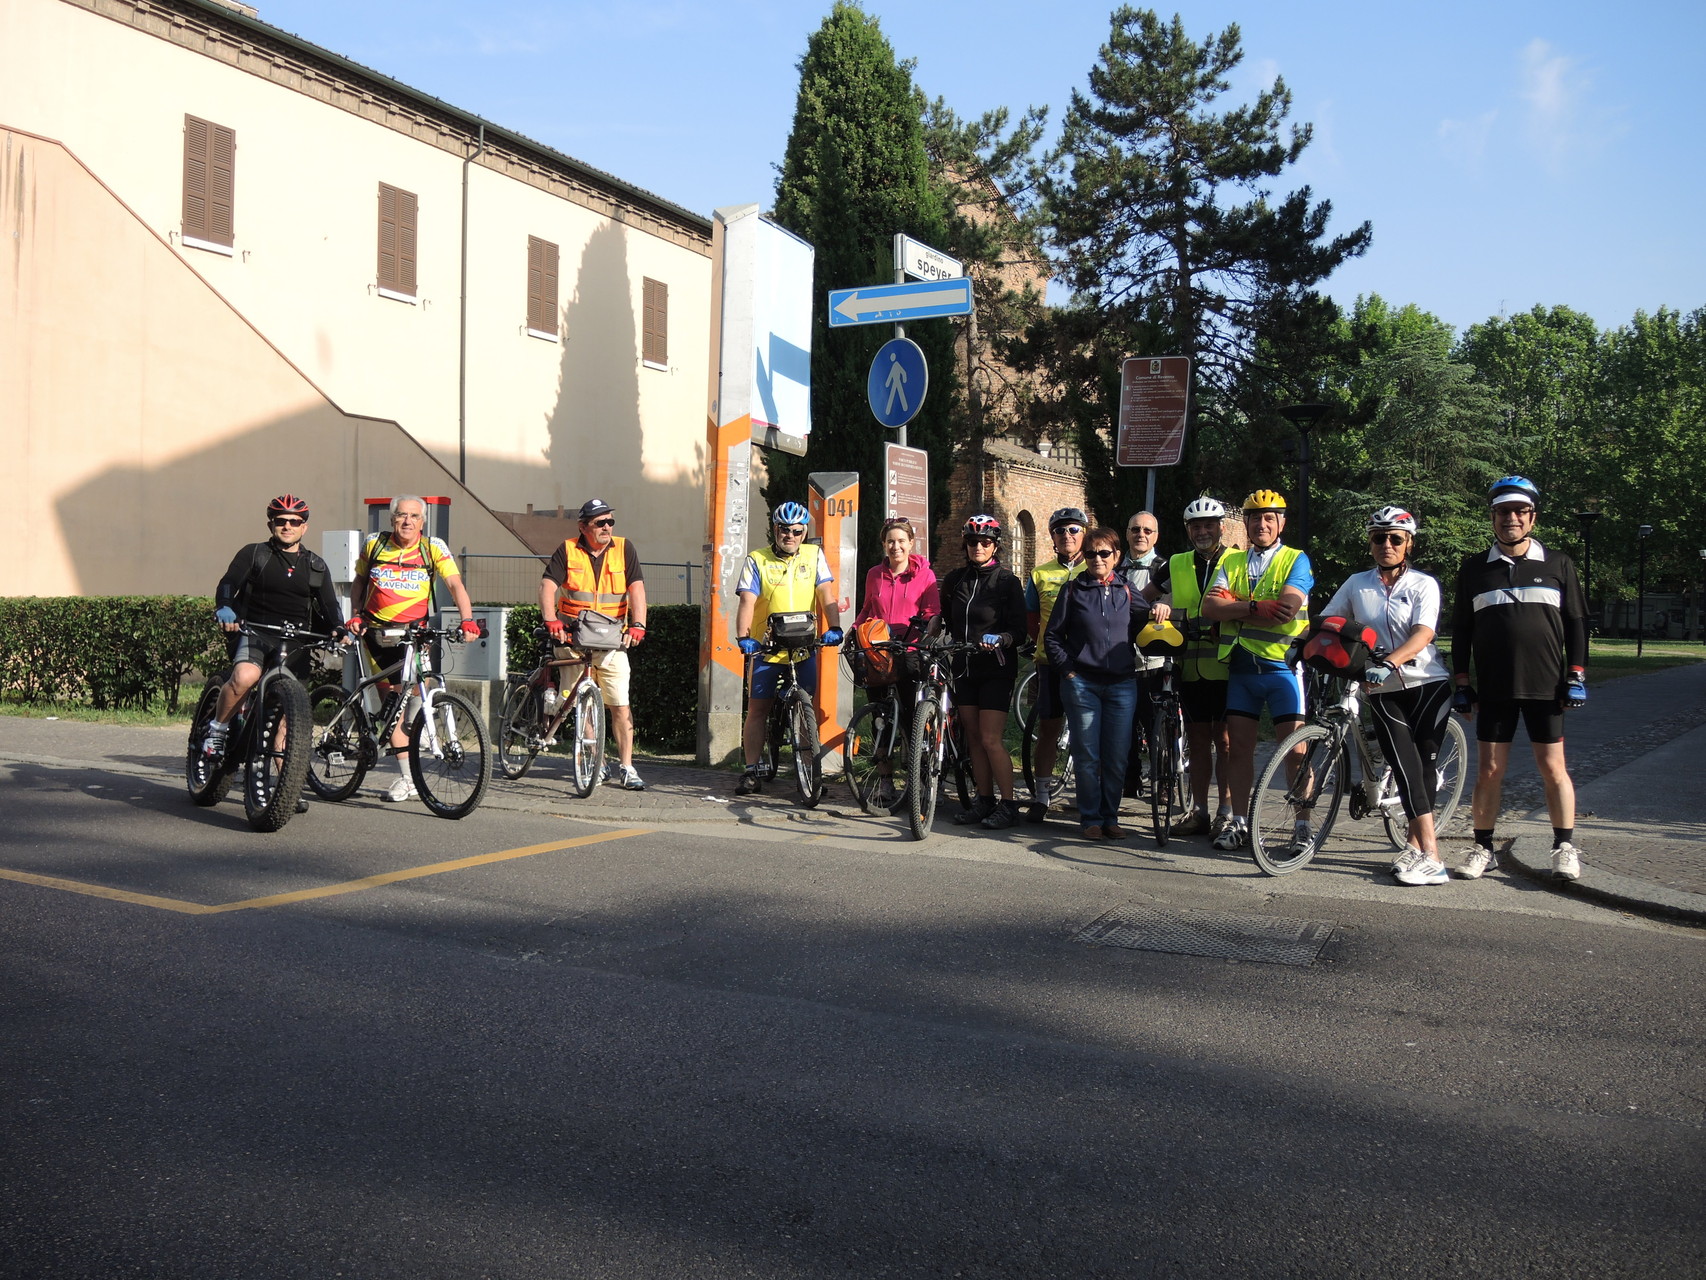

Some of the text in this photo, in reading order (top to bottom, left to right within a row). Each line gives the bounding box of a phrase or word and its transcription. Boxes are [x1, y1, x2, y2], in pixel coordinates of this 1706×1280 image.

[917, 258, 952, 280] speyer
[827, 497, 853, 517] 041
[377, 580, 419, 590] RAVENNA
